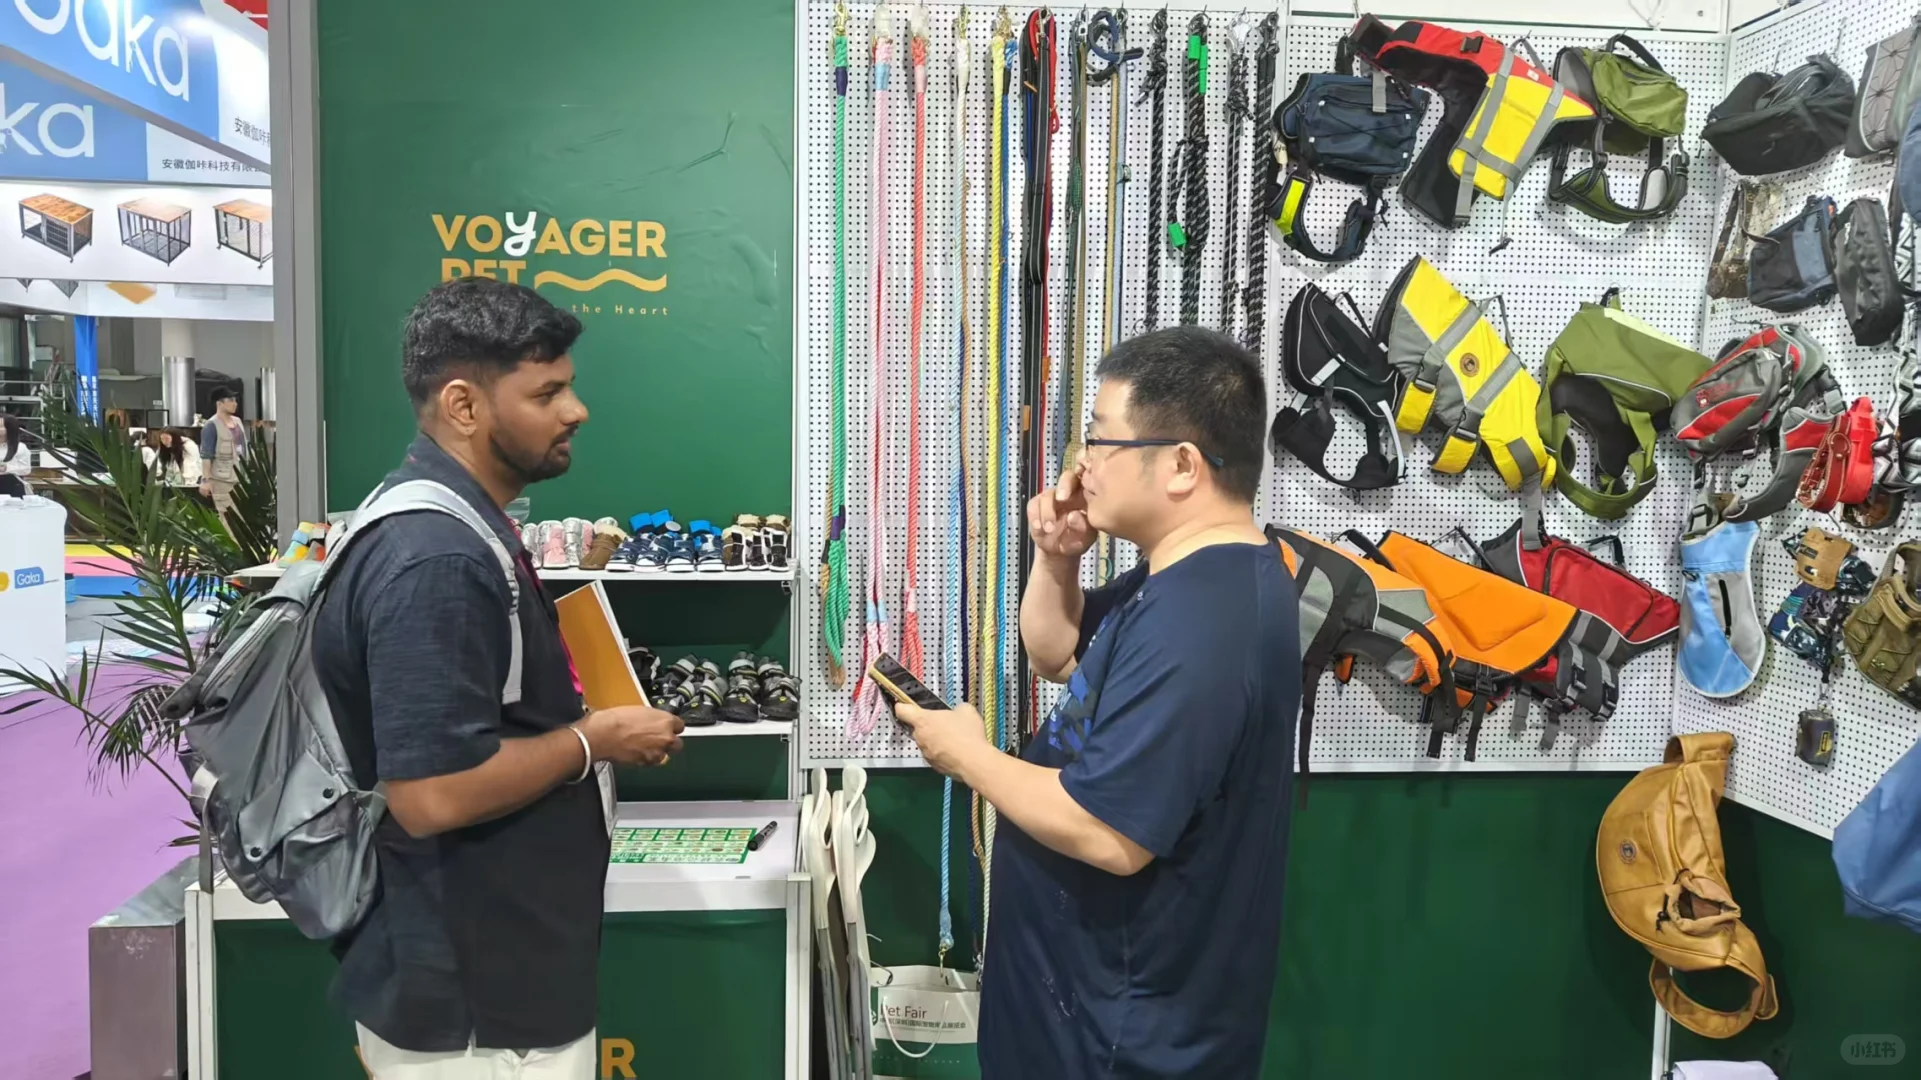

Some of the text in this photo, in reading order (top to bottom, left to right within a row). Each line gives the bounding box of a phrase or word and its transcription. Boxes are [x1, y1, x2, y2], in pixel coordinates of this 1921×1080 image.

[572, 303, 668, 316] the Heart
[904, 1006, 928, 1019] Fair
